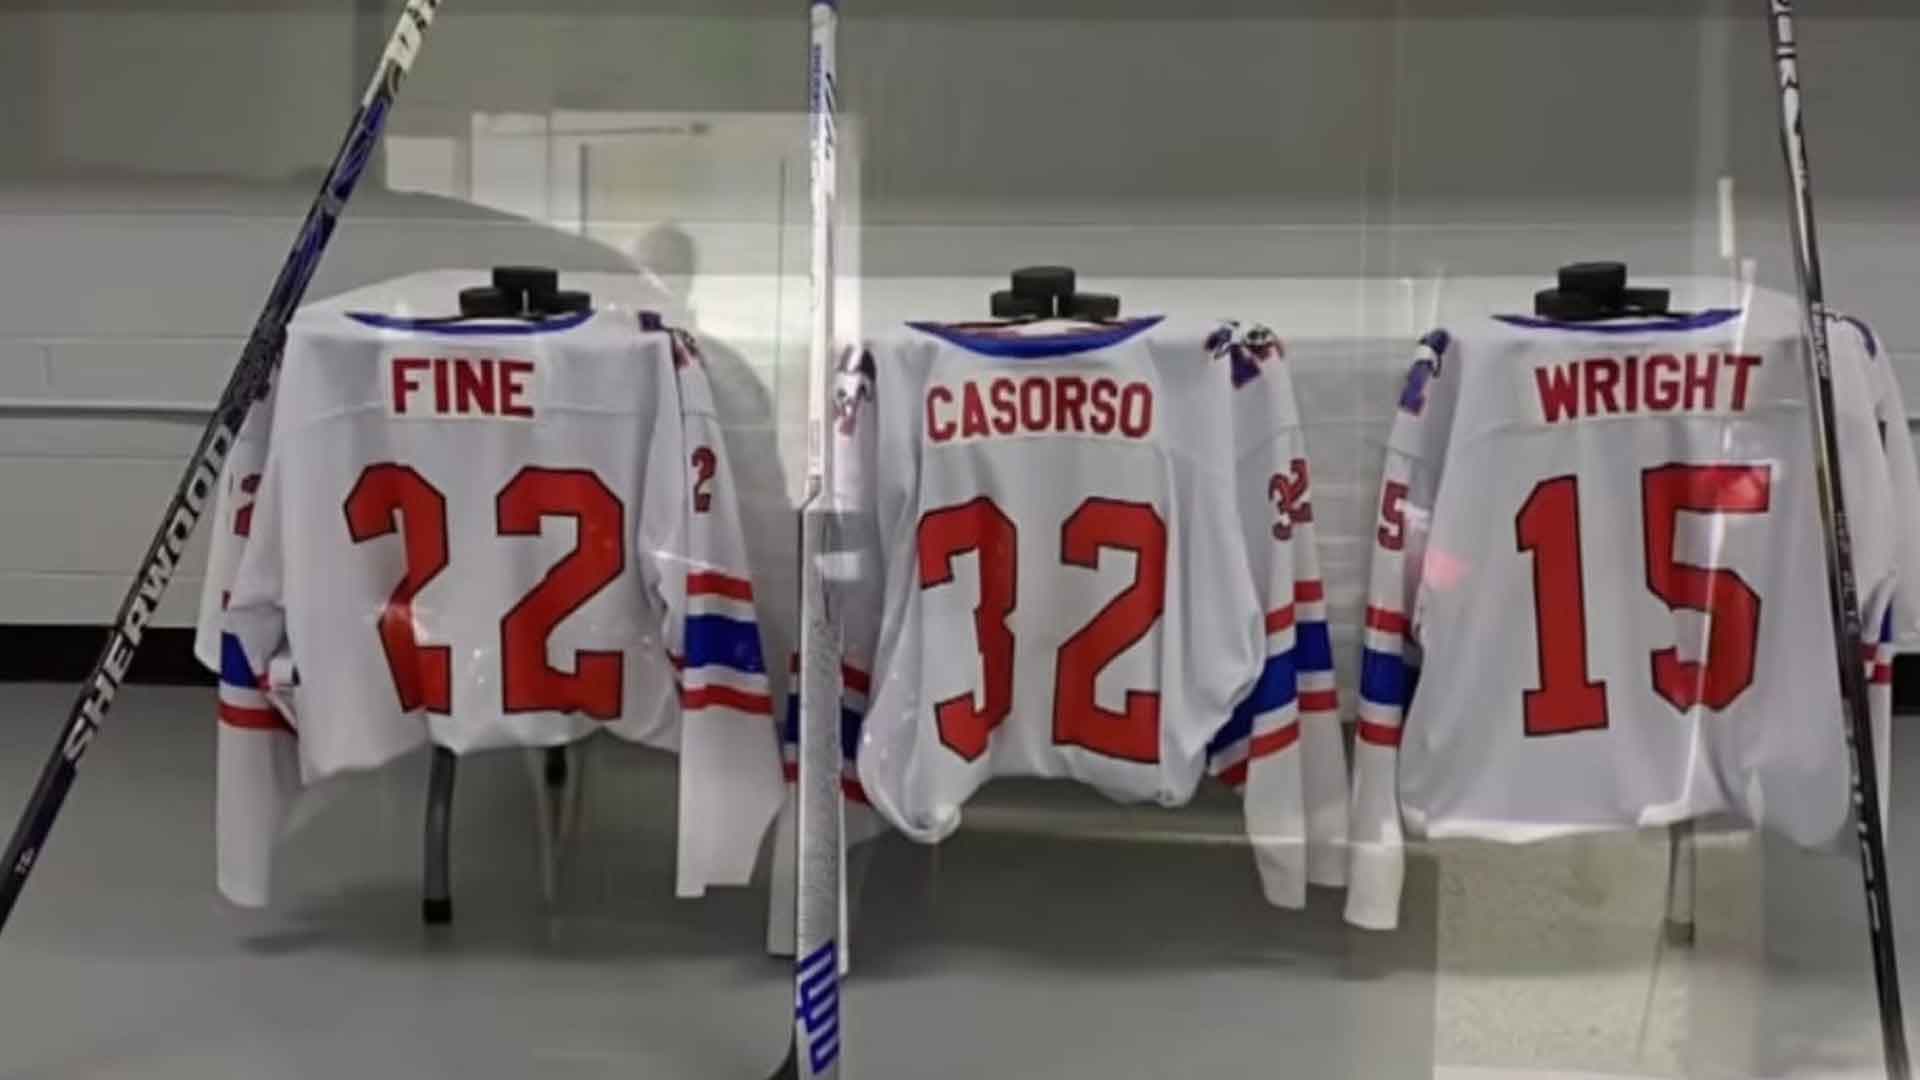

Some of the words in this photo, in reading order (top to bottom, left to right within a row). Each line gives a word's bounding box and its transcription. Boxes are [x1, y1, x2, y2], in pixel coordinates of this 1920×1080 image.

[392, 356, 536, 418] FINE
[926, 374, 1154, 443] CASORSO
[1534, 352, 1763, 425] WRIGHT
[1268, 457, 1313, 541] 32
[62, 421, 235, 766] SHERWOOD
[342, 462, 627, 722] 22
[916, 495, 1168, 764] 32
[1514, 460, 1773, 737] 15
